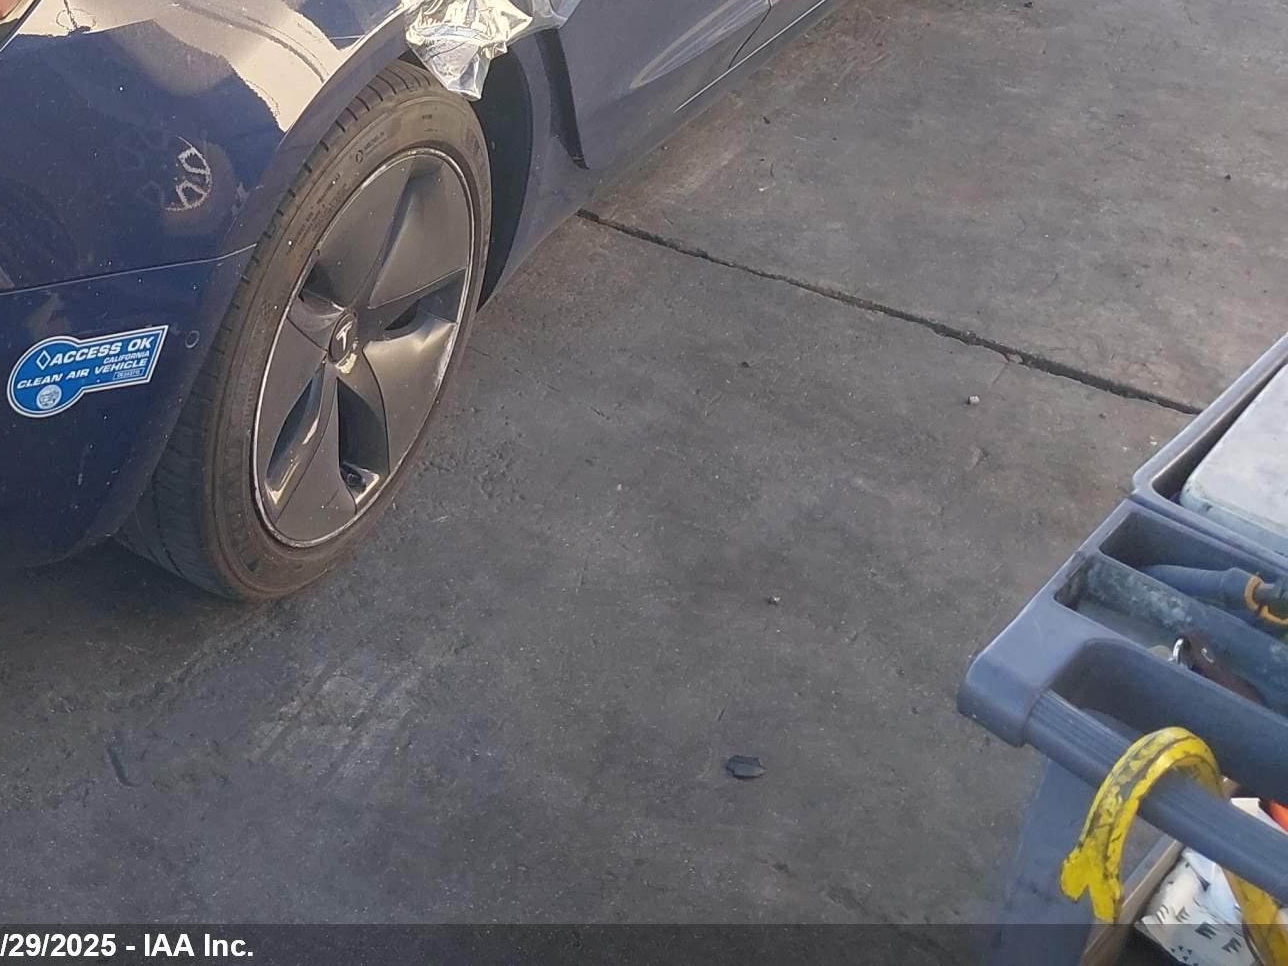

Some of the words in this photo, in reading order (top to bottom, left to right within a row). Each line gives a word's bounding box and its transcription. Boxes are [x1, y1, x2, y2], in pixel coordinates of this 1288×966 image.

[49, 342, 123, 367] ACCESS
[127, 336, 155, 352] OK
[103, 351, 150, 365] CALIFORNIA
[17, 372, 63, 389] CLEAN
[65, 368, 90, 380] AIR
[94, 357, 149, 375] VEHICLE
